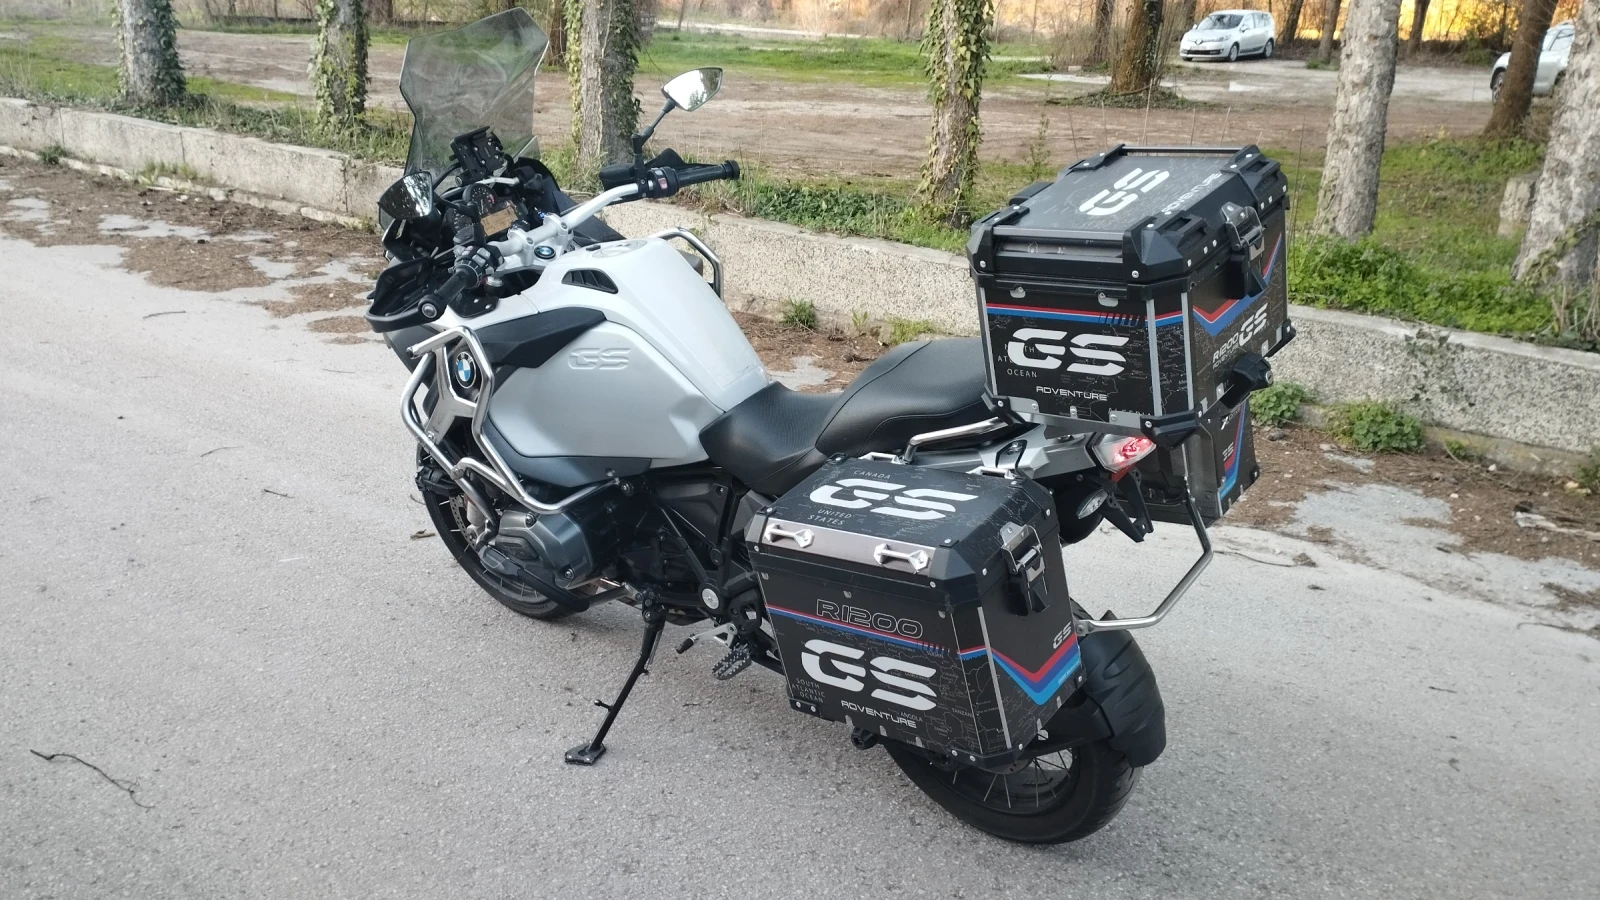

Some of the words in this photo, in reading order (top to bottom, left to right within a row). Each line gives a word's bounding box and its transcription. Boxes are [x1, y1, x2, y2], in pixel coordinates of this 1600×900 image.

[1079, 167, 1170, 216] GS
[1239, 302, 1268, 347] GS
[1004, 343, 1036, 354] NTH
[1007, 327, 1130, 376] GS
[567, 347, 631, 371] GS
[1006, 368, 1038, 378] OCEAN
[1036, 385, 1108, 401] ADVENTURE
[853, 469, 891, 480] CANADA
[809, 478, 979, 520] GS
[807, 514, 846, 526] STATES
[817, 508, 853, 519] UNITED
[816, 598, 923, 640] R1200
[1052, 620, 1072, 650] GS
[796, 677, 820, 689] SOUTH
[801, 639, 937, 711] GS
[791, 683, 826, 698] ATLANTIC
[799, 691, 824, 704] OCEAN
[840, 699, 918, 729] ADVENTURE
